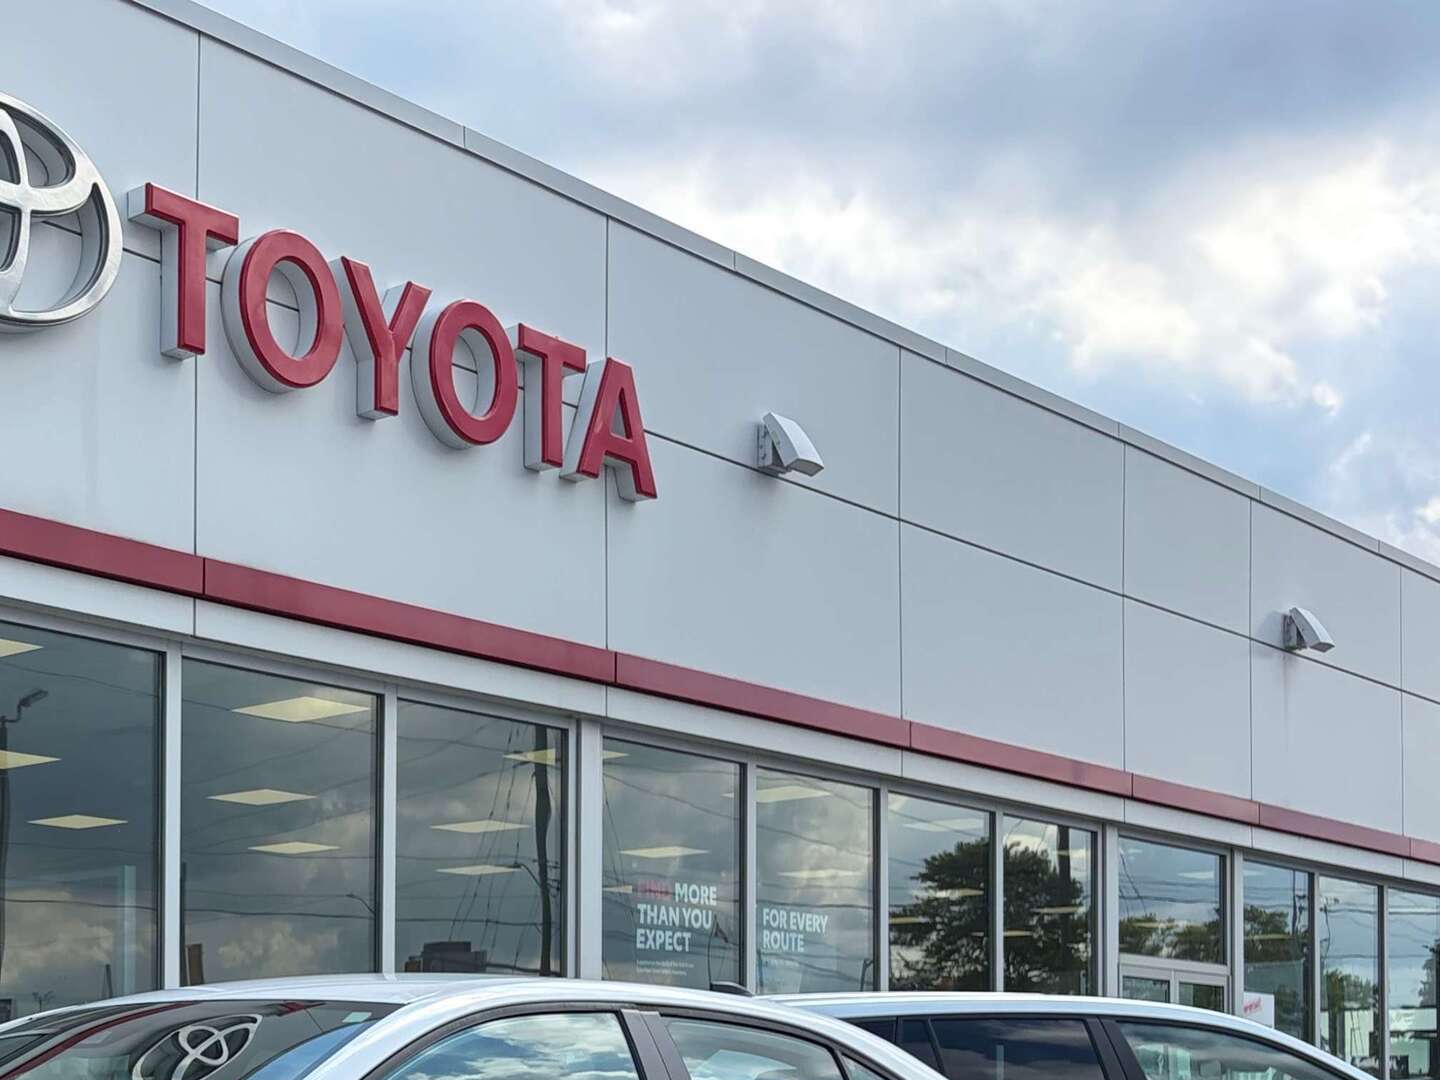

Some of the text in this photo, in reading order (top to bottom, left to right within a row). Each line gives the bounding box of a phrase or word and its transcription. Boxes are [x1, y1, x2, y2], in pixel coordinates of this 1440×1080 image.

[130, 182, 657, 502] TOYOTA
[675, 882, 717, 906] MORE
[637, 903, 712, 929] THAN YOU
[763, 908, 829, 934] FOR EVERY
[636, 928, 692, 952] EXPECT
[763, 930, 805, 952] ROUTE
